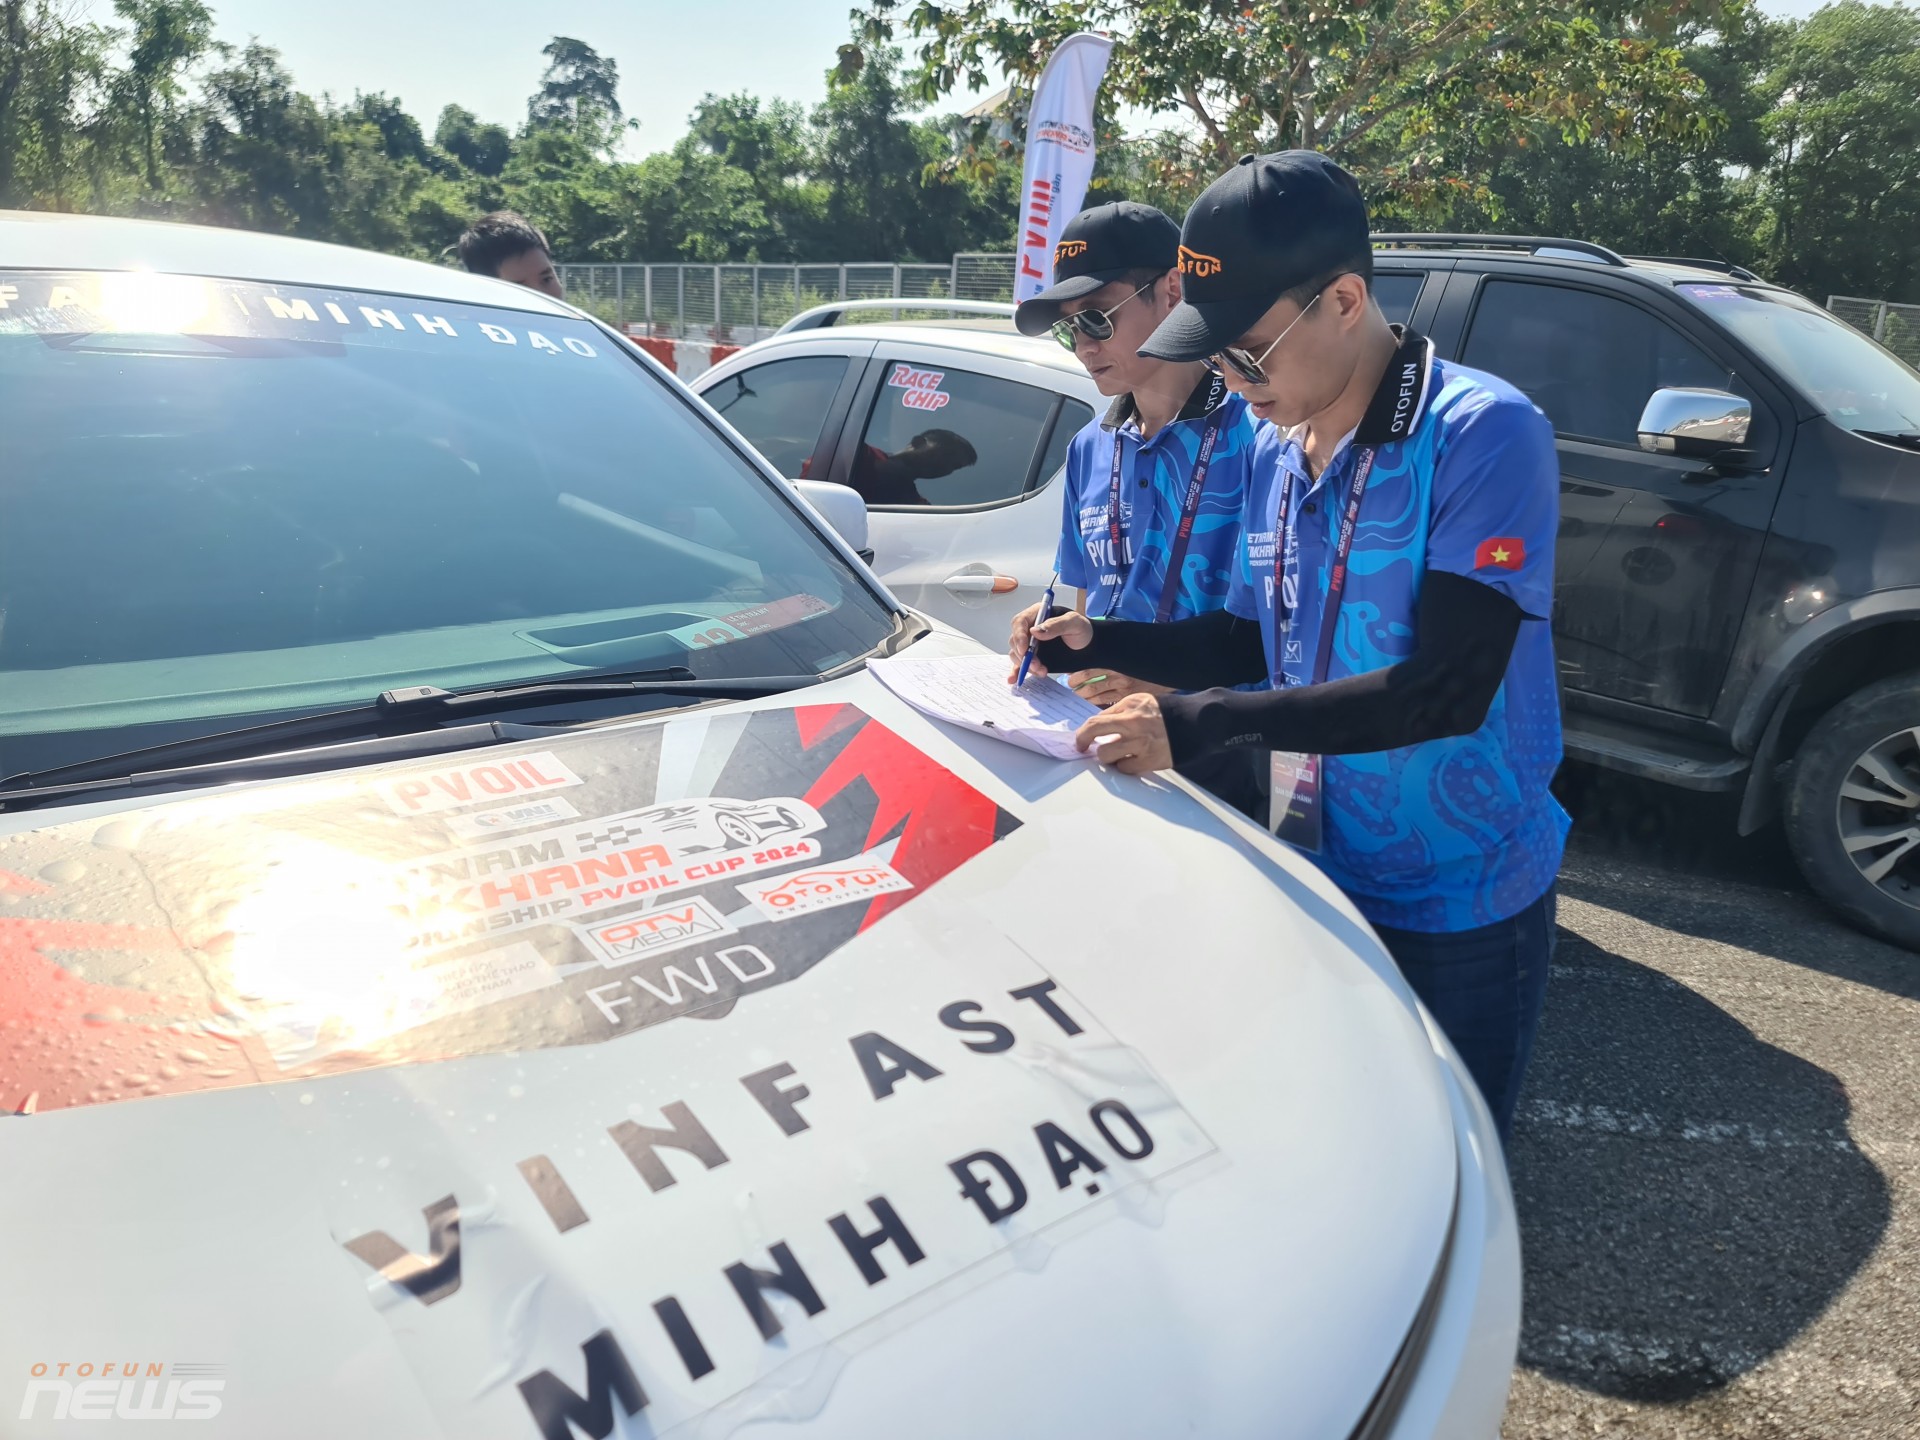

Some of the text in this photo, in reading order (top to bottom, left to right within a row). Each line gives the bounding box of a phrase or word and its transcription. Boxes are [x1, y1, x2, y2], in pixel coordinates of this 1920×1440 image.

[263, 296, 458, 337] MINH
[478, 322, 598, 358] ĐẠO
[889, 366, 943, 390] RACE
[1205, 376, 1224, 410] OTOF
[903, 390, 949, 409] CHIP
[1391, 363, 1417, 432] OTOFUN
[1179, 516, 1192, 538] PVOIL
[1086, 537, 1135, 567] PVOIL
[1331, 565, 1344, 591] PVOIL
[393, 760, 566, 810] PVOIL
[580, 874, 679, 907] PVOIL
[684, 856, 745, 880] CUP
[752, 842, 811, 864] 2024
[768, 873, 892, 907] OTOFUN
[600, 906, 694, 943] OTV
[611, 921, 719, 954] MEDIA
[585, 944, 776, 1024] FWD
[345, 978, 1085, 1306] VINFAST
[516, 1099, 1156, 1440] MINH ĐẠO
